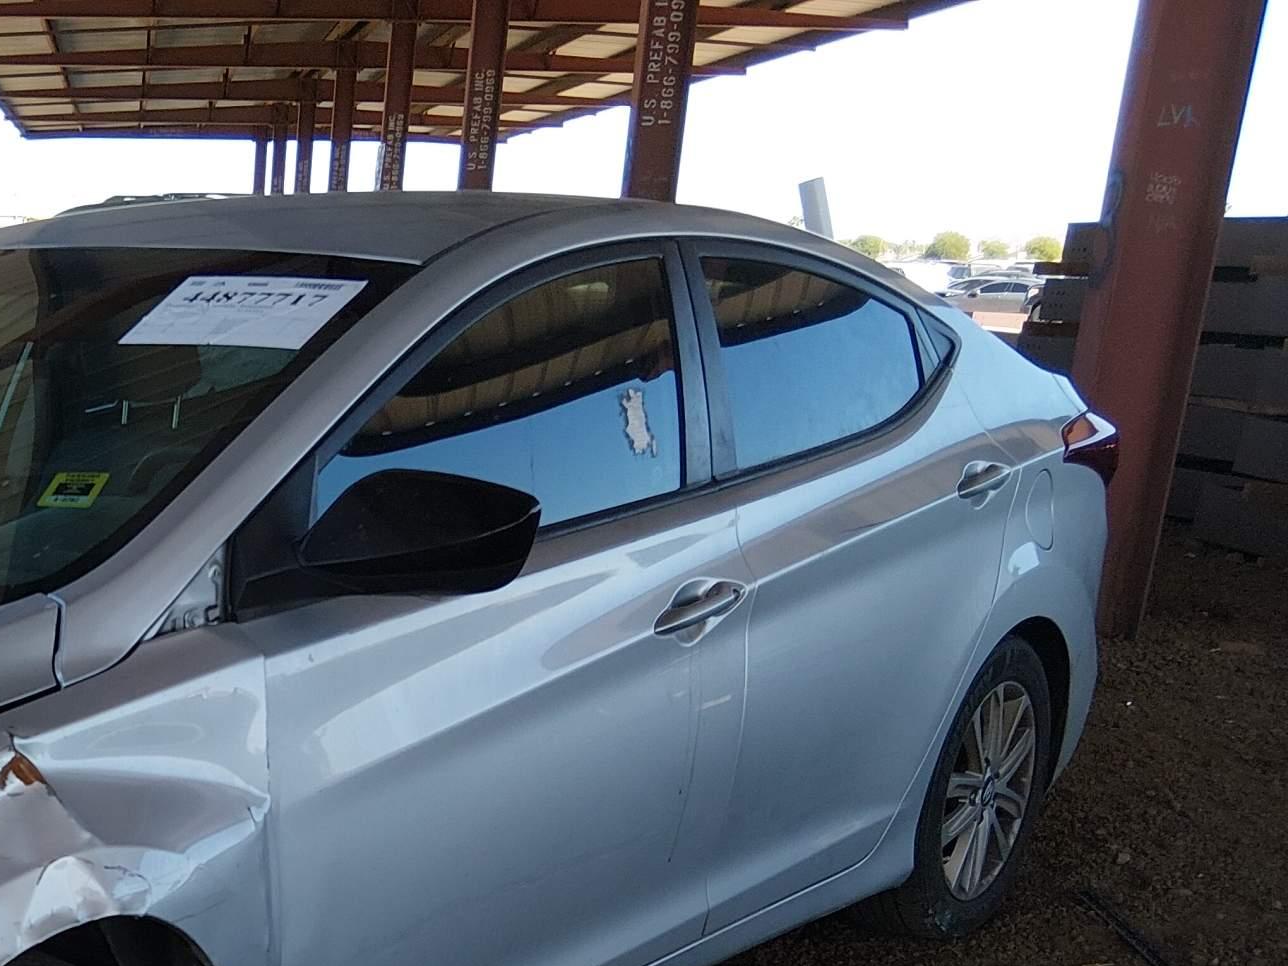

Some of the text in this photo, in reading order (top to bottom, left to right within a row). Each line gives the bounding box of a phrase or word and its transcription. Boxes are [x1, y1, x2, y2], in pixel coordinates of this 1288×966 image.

[646, 16, 667, 83] PREFAB
[469, 97, 483, 142] PREFAB
[184, 290, 329, 307] 44877717
